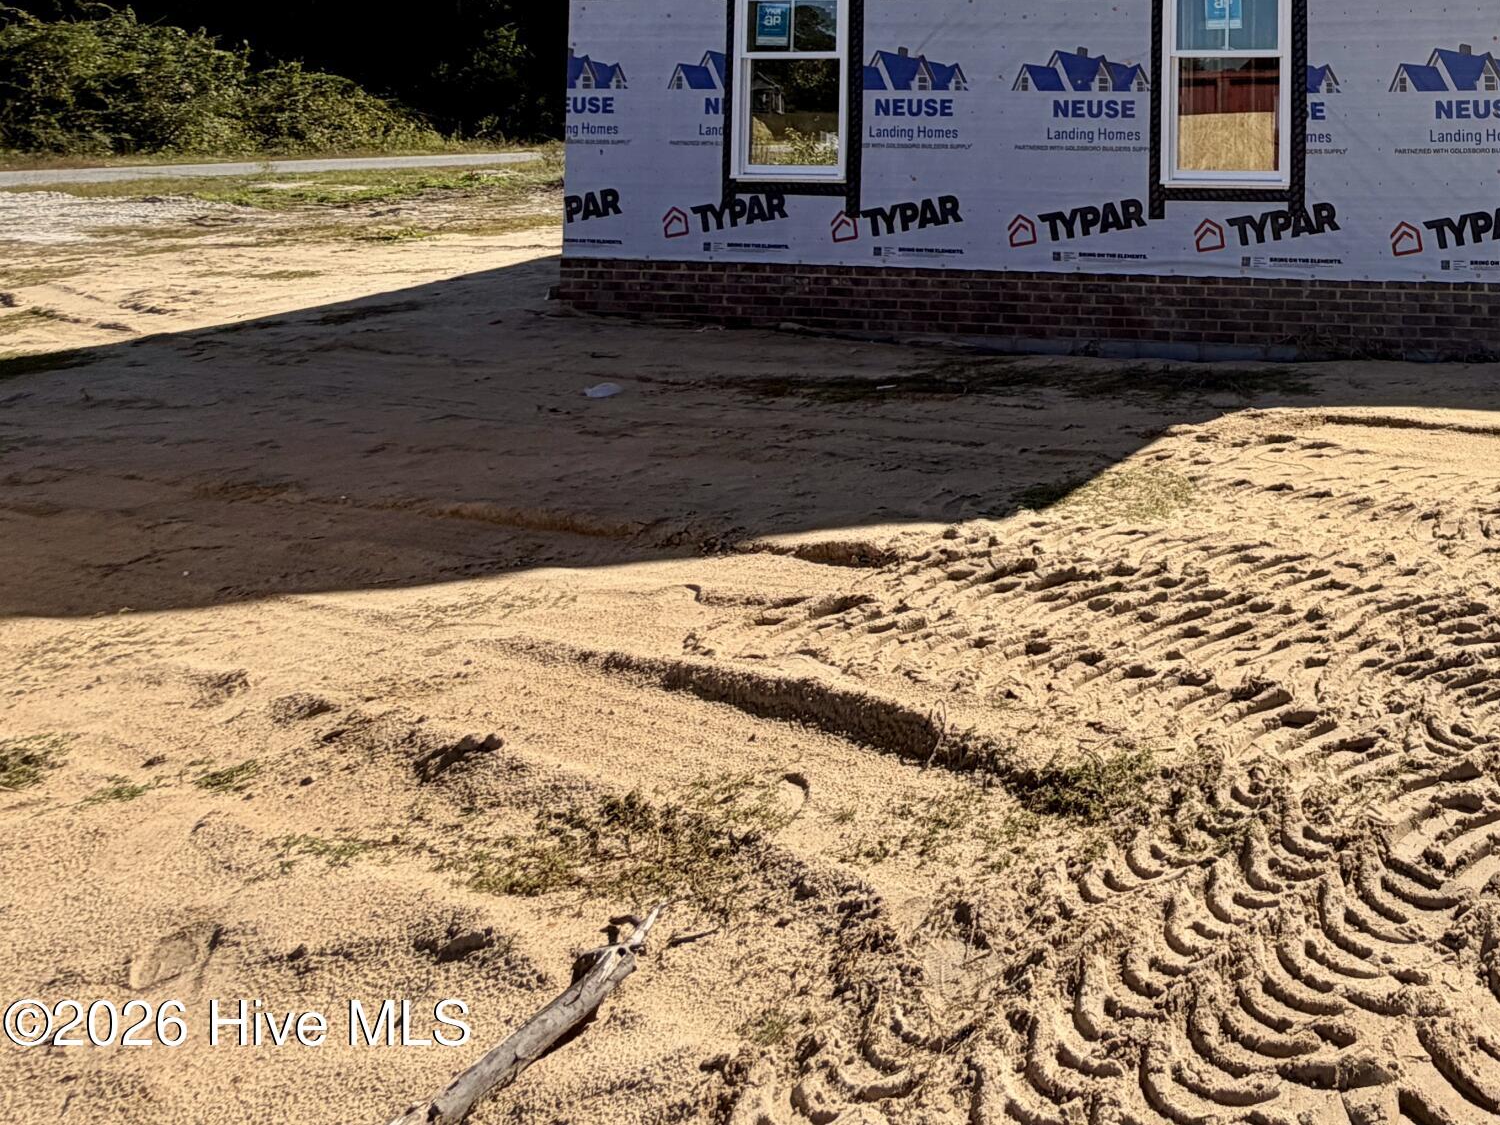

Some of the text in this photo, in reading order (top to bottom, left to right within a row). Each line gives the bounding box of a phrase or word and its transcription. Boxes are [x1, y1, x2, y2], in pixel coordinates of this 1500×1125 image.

[875, 98, 954, 117] NEUSE
[1053, 99, 1136, 119] NEUSE
[582, 123, 618, 134] Homes
[869, 126, 958, 141] Landing Homes
[1047, 128, 1141, 143] Landing Homes
[1430, 129, 1481, 145] Landing
[690, 194, 789, 232] TYPAR
[860, 195, 964, 237] TYPAR
[1037, 199, 1147, 241] TYPAR
[1226, 202, 1341, 246] TYPAR
